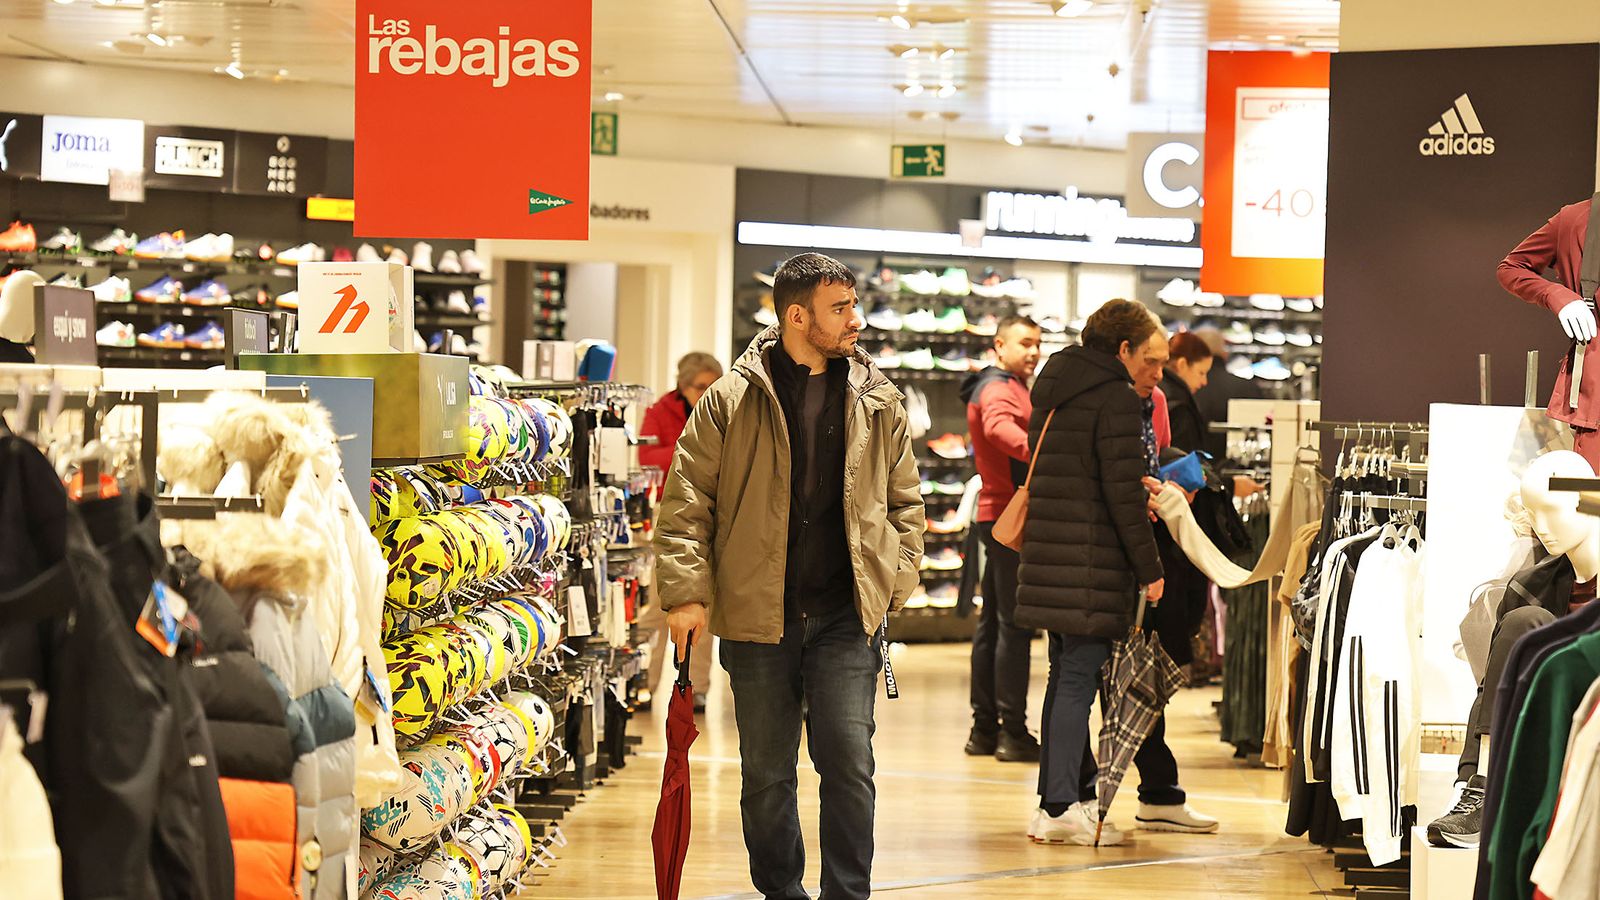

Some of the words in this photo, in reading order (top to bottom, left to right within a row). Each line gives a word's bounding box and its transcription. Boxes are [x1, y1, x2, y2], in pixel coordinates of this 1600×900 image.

[369, 14, 410, 35] Las
[369, 25, 580, 88] rebajas
[1419, 133, 1495, 156] adidas
[1143, 142, 1204, 209] C
[881, 640, 897, 695] MOLOTOW
